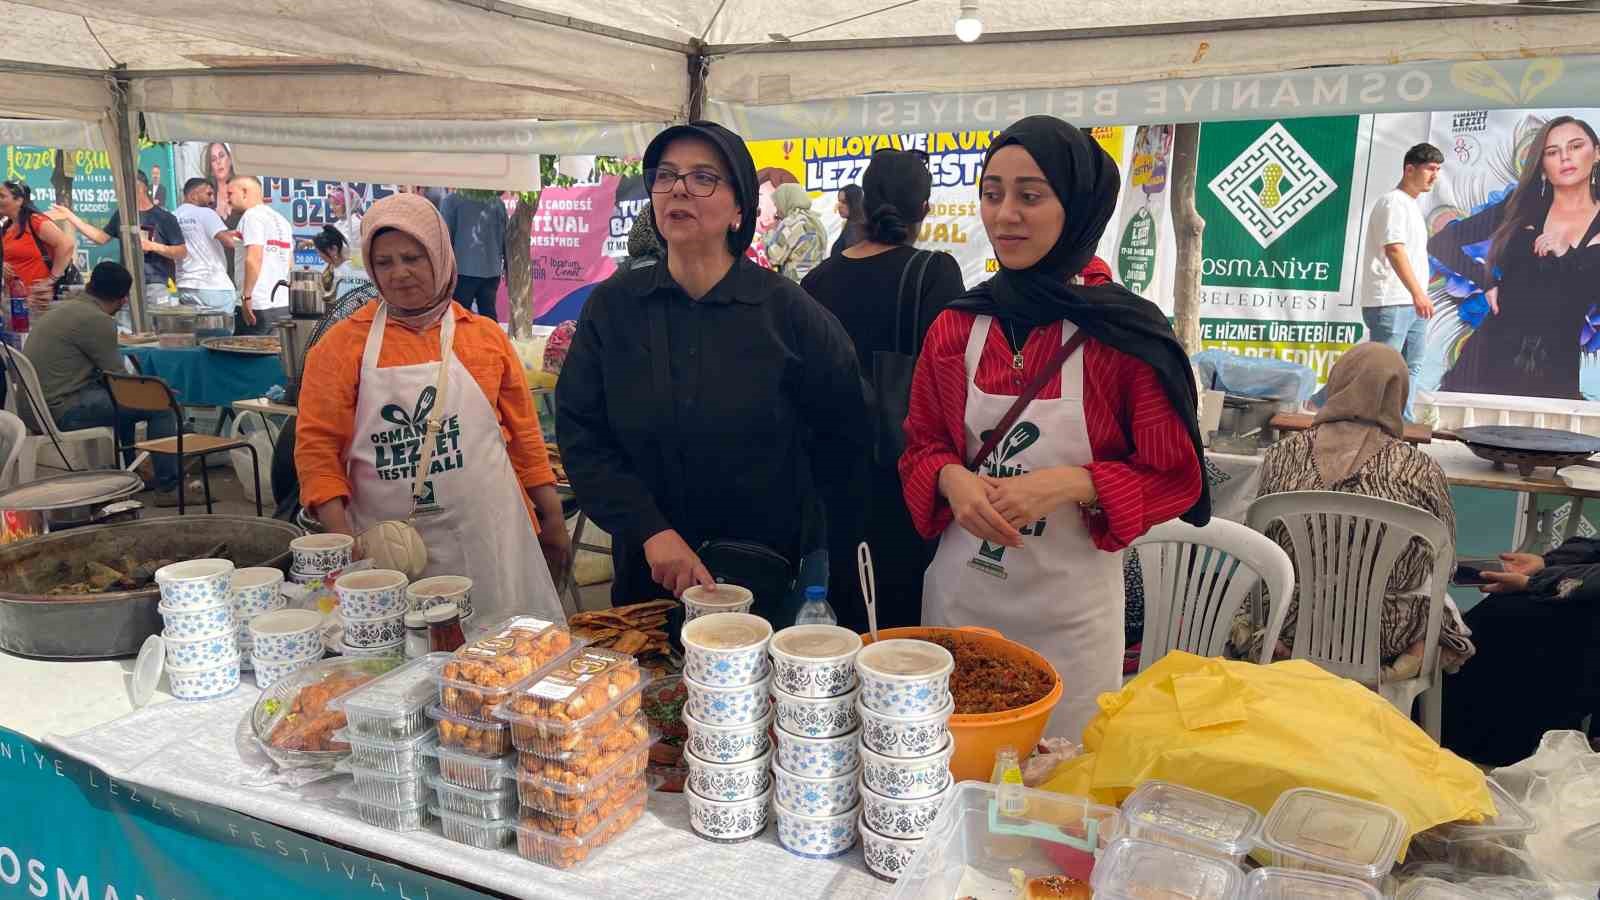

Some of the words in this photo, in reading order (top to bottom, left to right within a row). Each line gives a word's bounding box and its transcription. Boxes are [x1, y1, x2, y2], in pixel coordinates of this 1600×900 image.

[532, 211, 590, 233] TİVAL
[1201, 257, 1330, 281] OSMANİYE
[1215, 321, 1266, 341] HİZMET
[1269, 322, 1356, 344] ÜRETEBİLEN
[374, 430, 460, 469] LEZET
[377, 450, 464, 481] FESTİALİ
